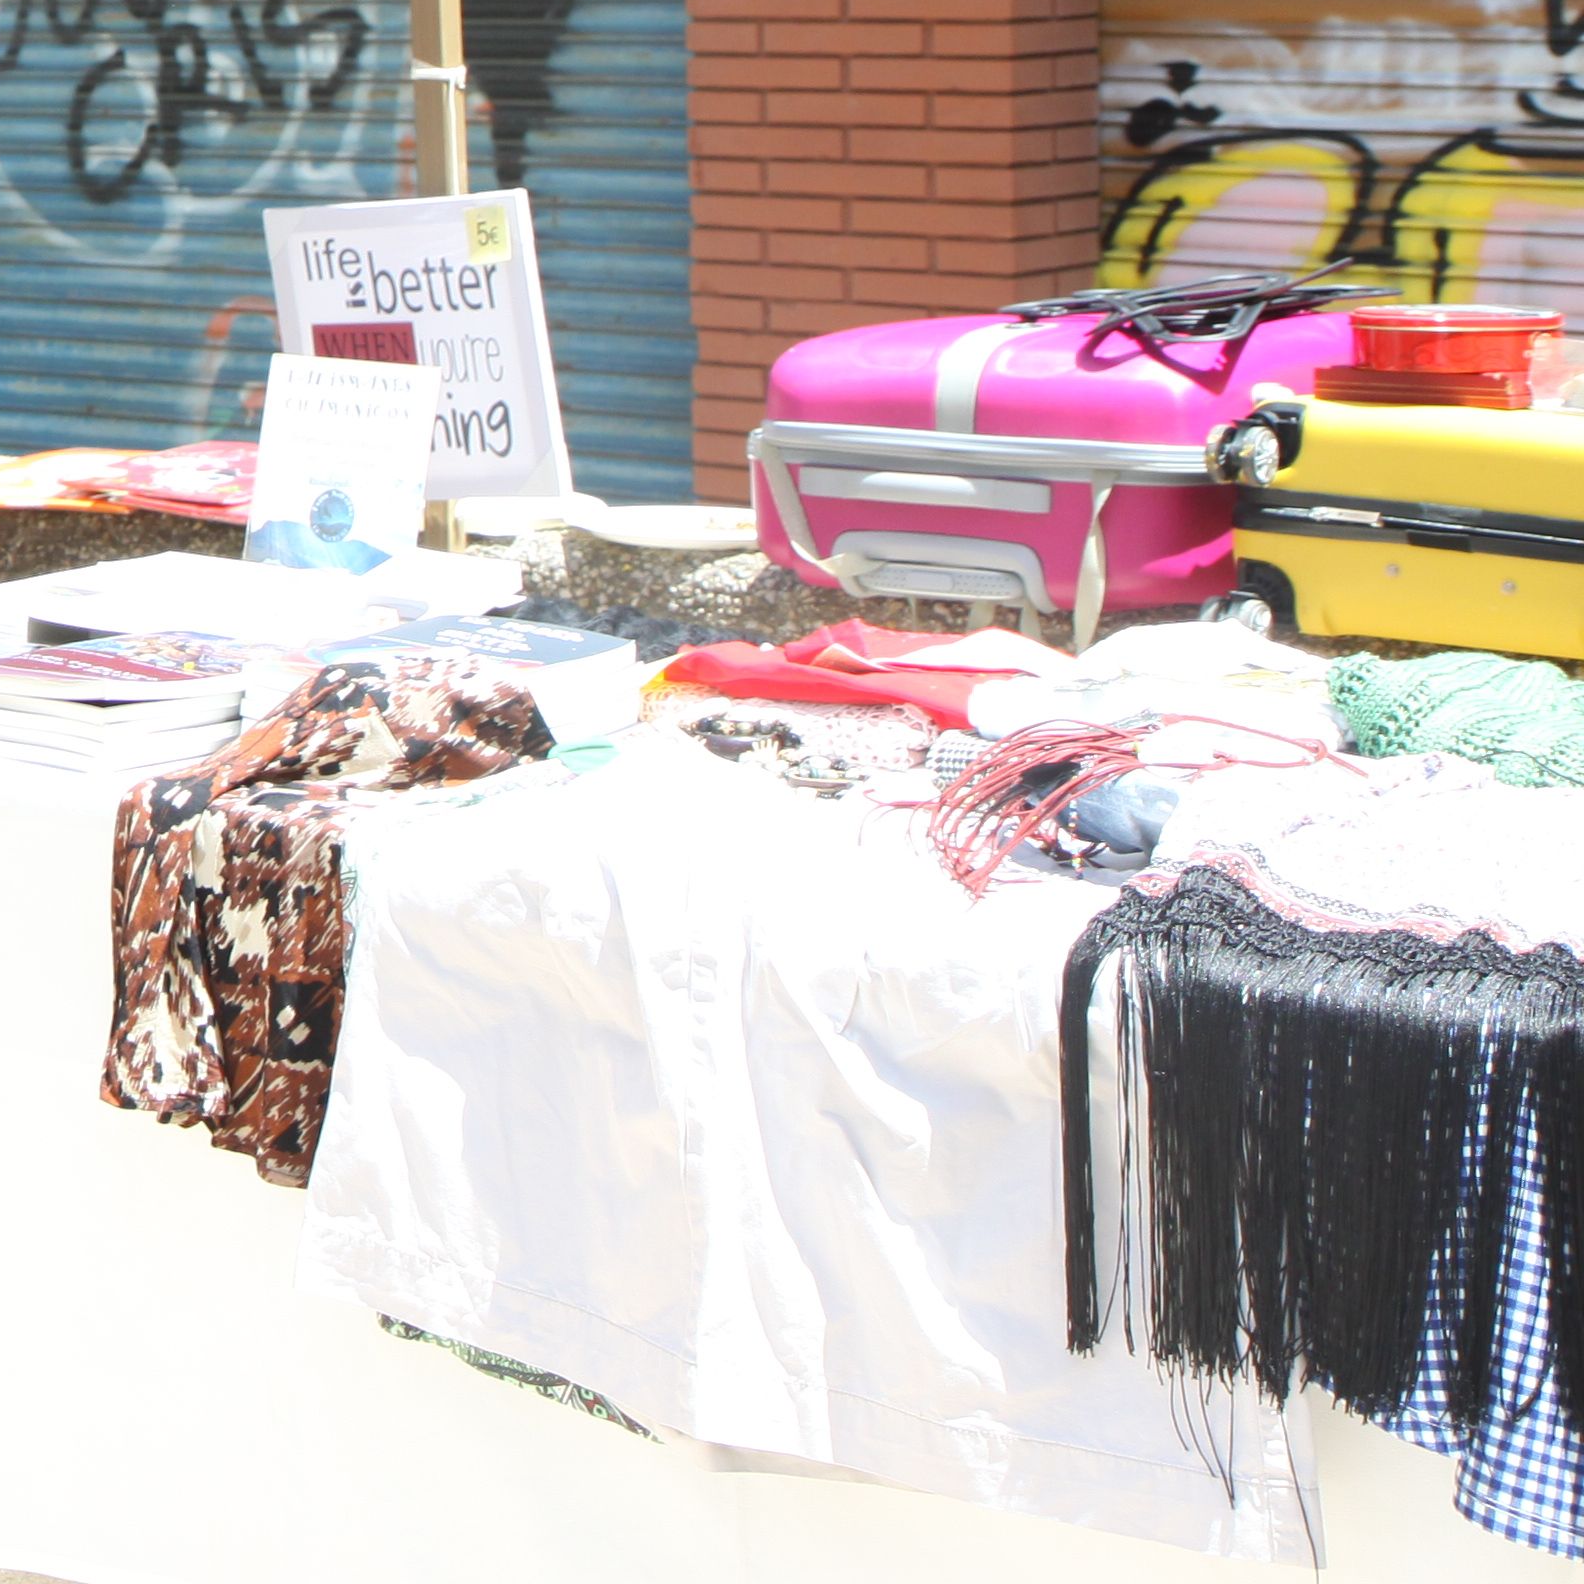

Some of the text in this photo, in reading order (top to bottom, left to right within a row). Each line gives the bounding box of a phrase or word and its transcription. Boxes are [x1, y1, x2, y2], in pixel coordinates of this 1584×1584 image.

[476, 222, 500, 247] 5€
[302, 238, 362, 282] life
[368, 250, 499, 314] better
[320, 330, 412, 362] WHEN
